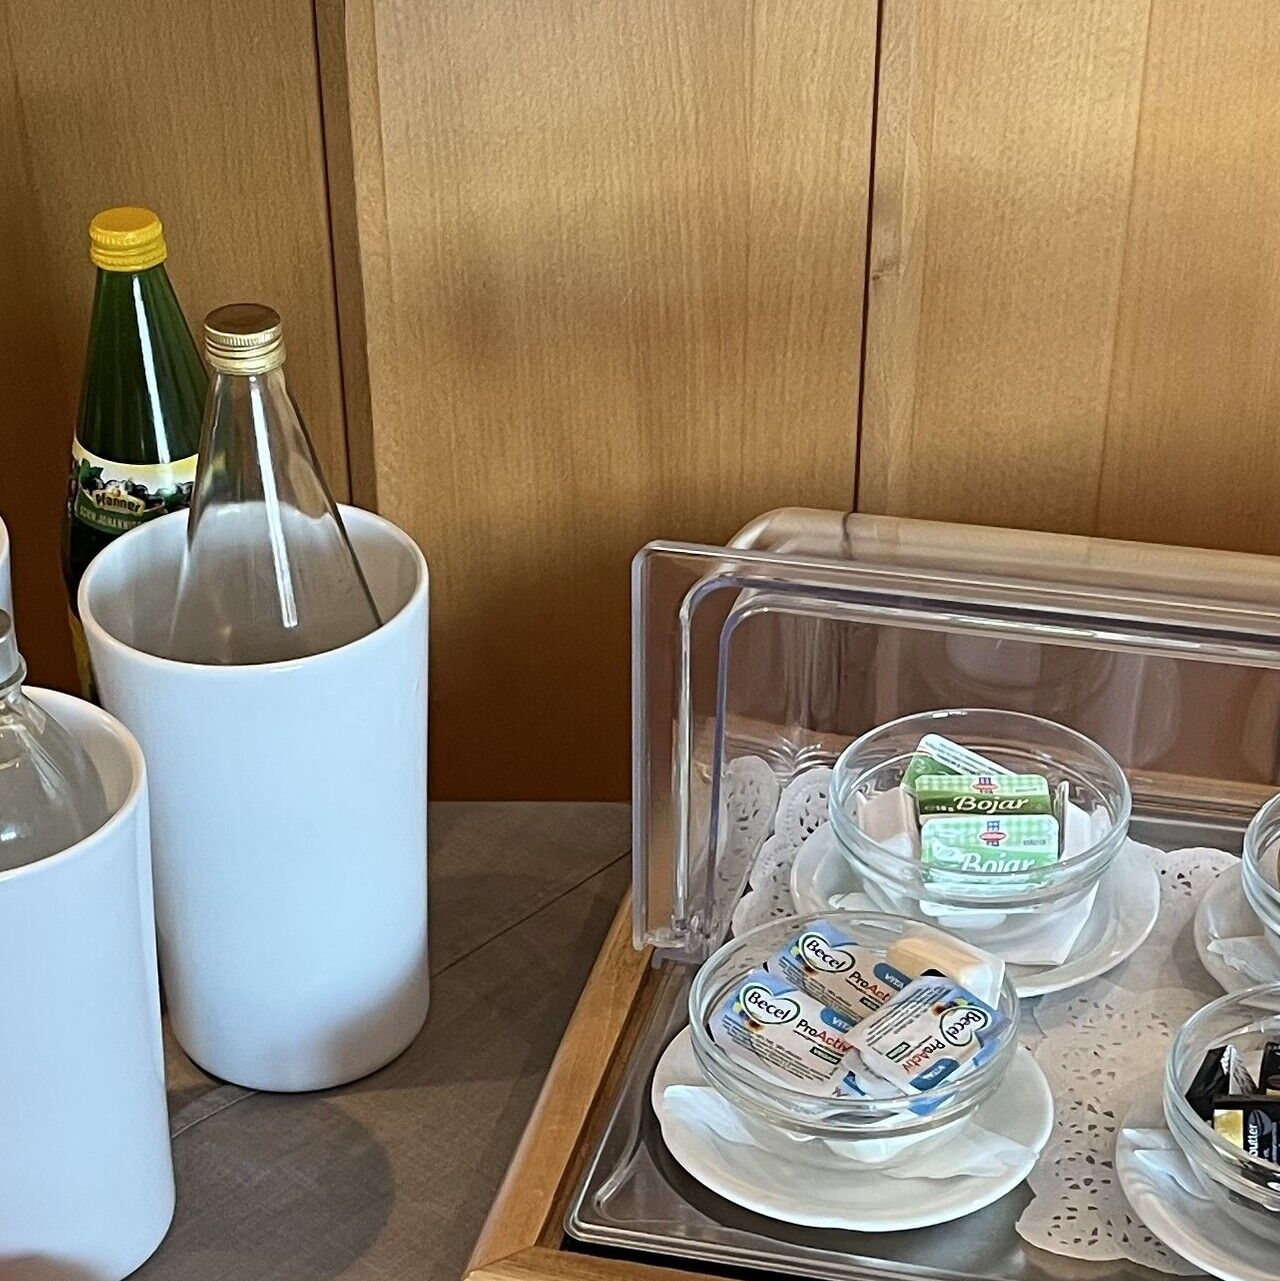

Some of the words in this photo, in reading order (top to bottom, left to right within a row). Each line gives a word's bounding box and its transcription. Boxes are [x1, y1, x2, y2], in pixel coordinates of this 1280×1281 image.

[953, 795, 1029, 814] Bojar
[806, 939, 846, 970] Becel
[848, 970, 891, 1001] ProAct
[747, 991, 791, 1021] Becel
[795, 1018, 855, 1052] ProActiv
[946, 1011, 982, 1040] Becel
[902, 1038, 945, 1073] ProActiv
[1247, 1123, 1259, 1158] butter
